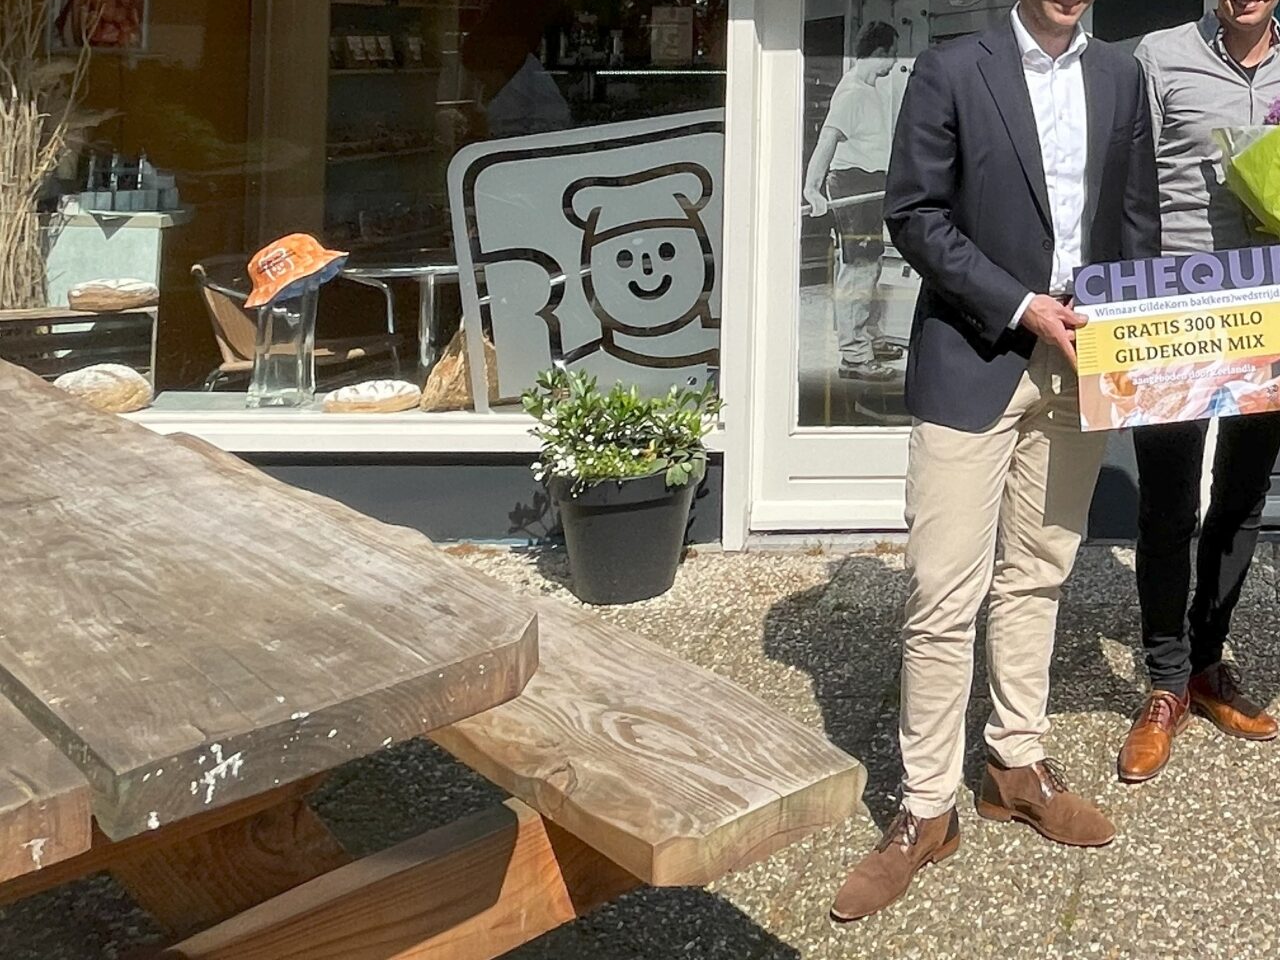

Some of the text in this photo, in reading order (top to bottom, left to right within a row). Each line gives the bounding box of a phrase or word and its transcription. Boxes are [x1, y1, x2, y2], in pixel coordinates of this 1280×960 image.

[1095, 305, 1137, 317] Winnaar
[1190, 288, 1280, 308] bak(kers)wedstrijd
[1113, 311, 1263, 340] GRATIS 300 KILO
[1115, 334, 1266, 364] GILDEKORN MIX
[1132, 372, 1187, 386] aangeboden
[1188, 369, 1209, 381] door
